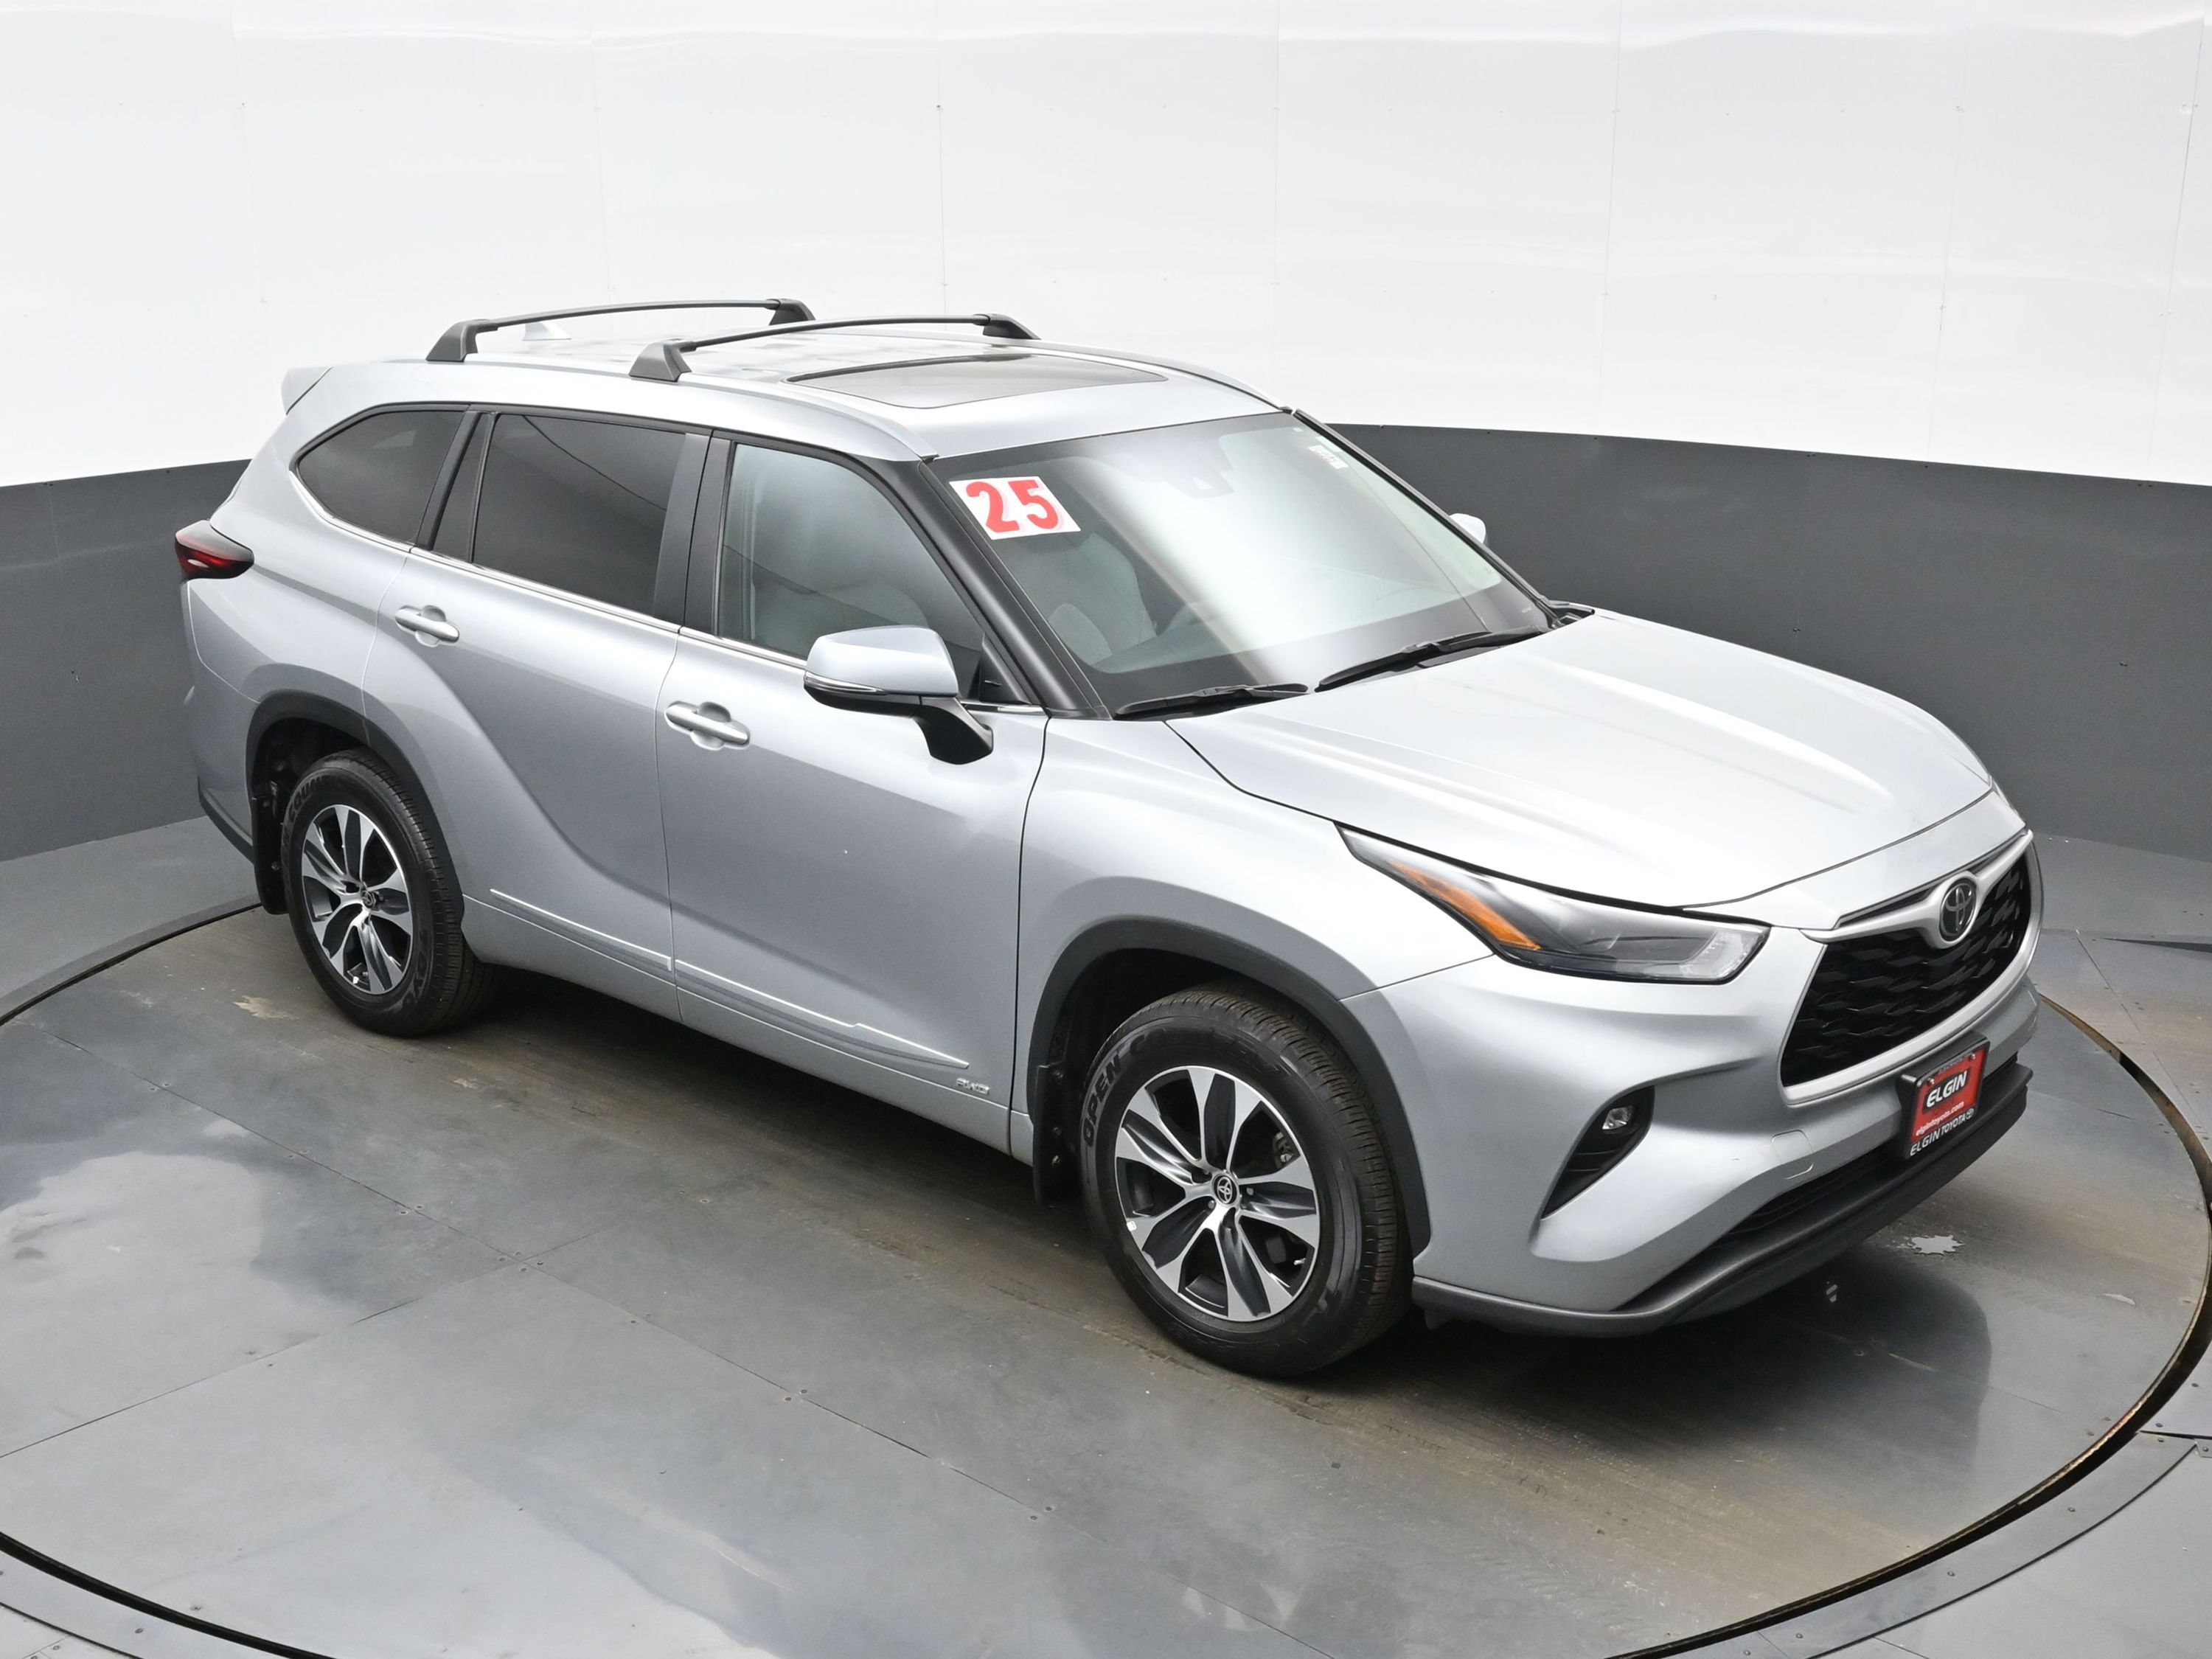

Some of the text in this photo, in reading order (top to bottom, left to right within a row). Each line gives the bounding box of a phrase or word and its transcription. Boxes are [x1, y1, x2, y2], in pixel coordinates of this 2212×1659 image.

[966, 479, 1060, 533] 25
[1083, 1054, 1121, 1147] OPEN
[1926, 1071, 1968, 1107] ELGIN
[1910, 1114, 1966, 1156] ELGIN TOYOTA
[1916, 1101, 1965, 1136] elgintoyota.com
